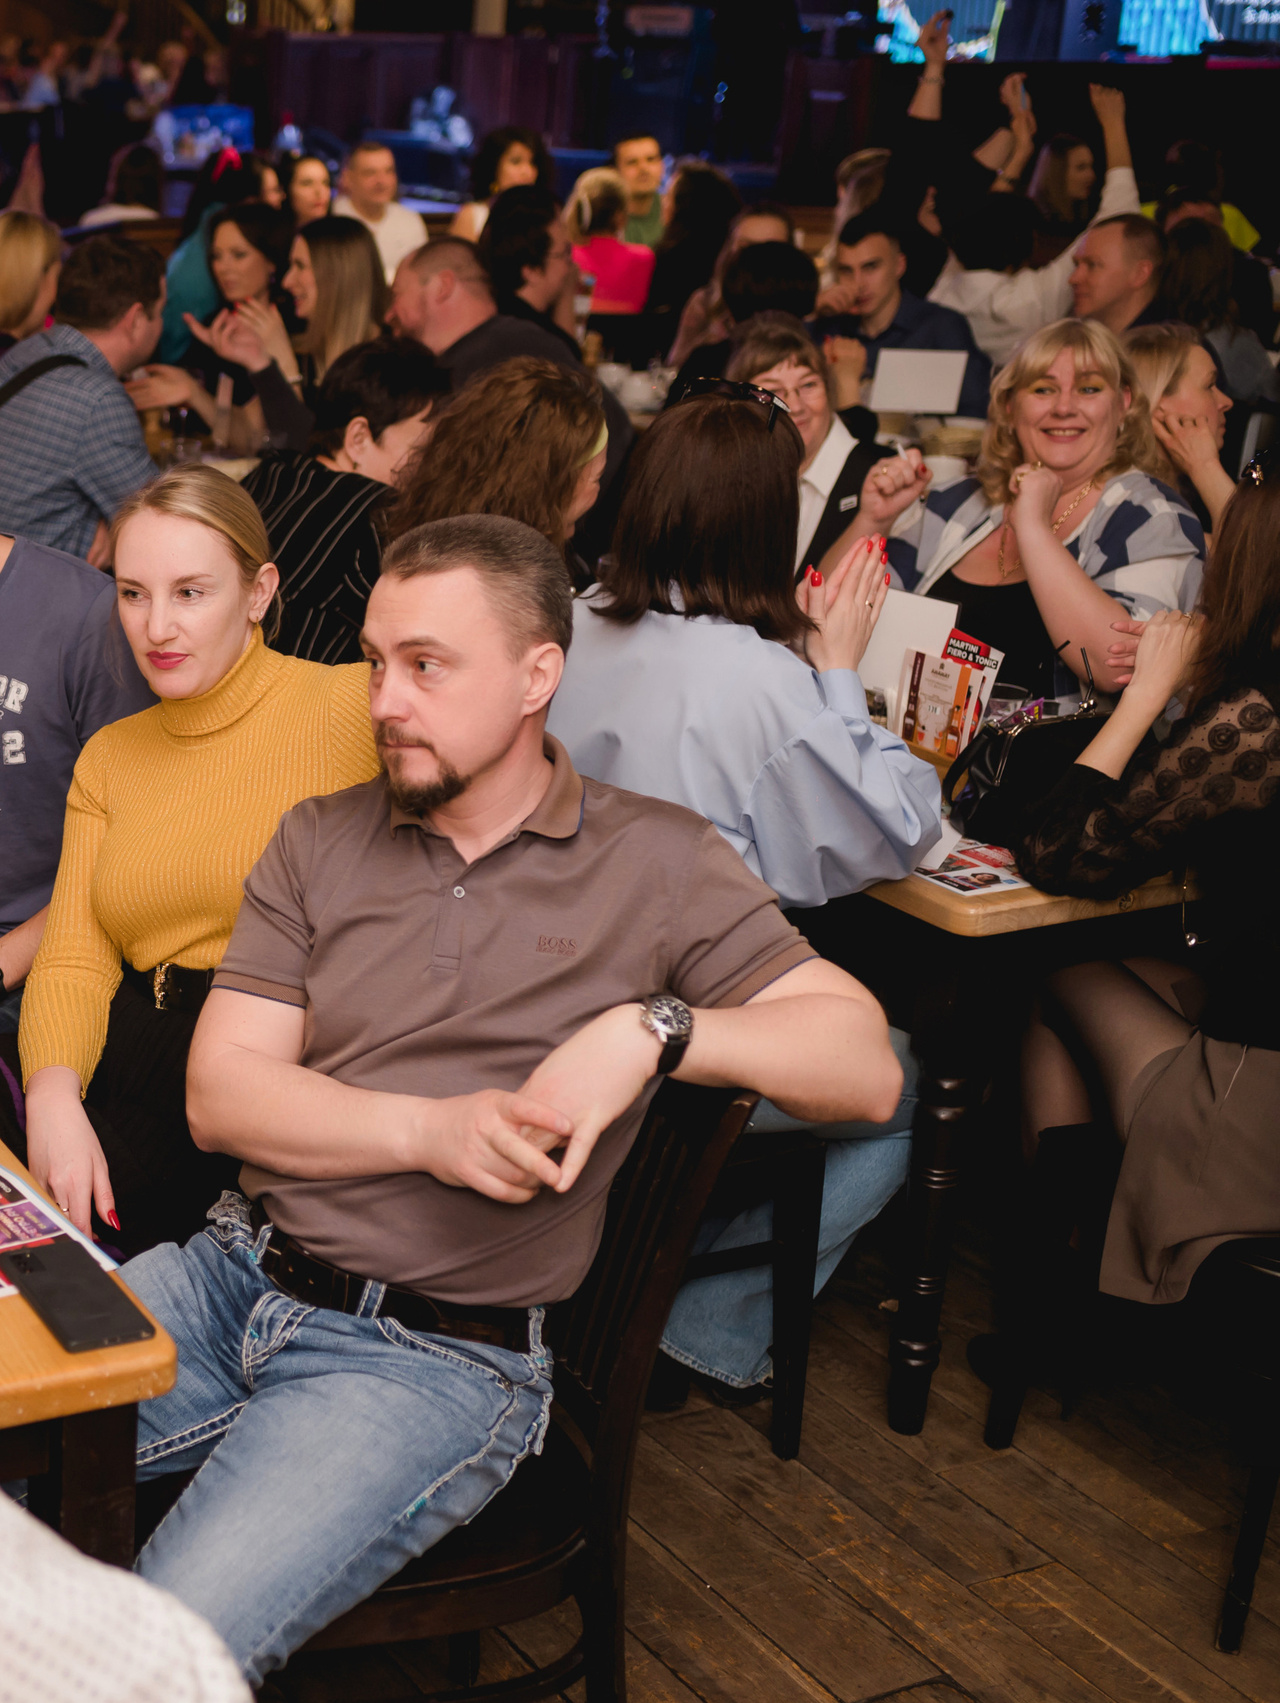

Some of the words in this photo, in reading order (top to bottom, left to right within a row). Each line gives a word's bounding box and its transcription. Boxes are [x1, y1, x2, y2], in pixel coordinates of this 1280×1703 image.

[948, 638, 979, 654] MARTINI
[947, 647, 968, 659] FIERO
[968, 653, 974, 662] &
[974, 654, 997, 669] TONIC
[538, 935, 577, 949] BOSS
